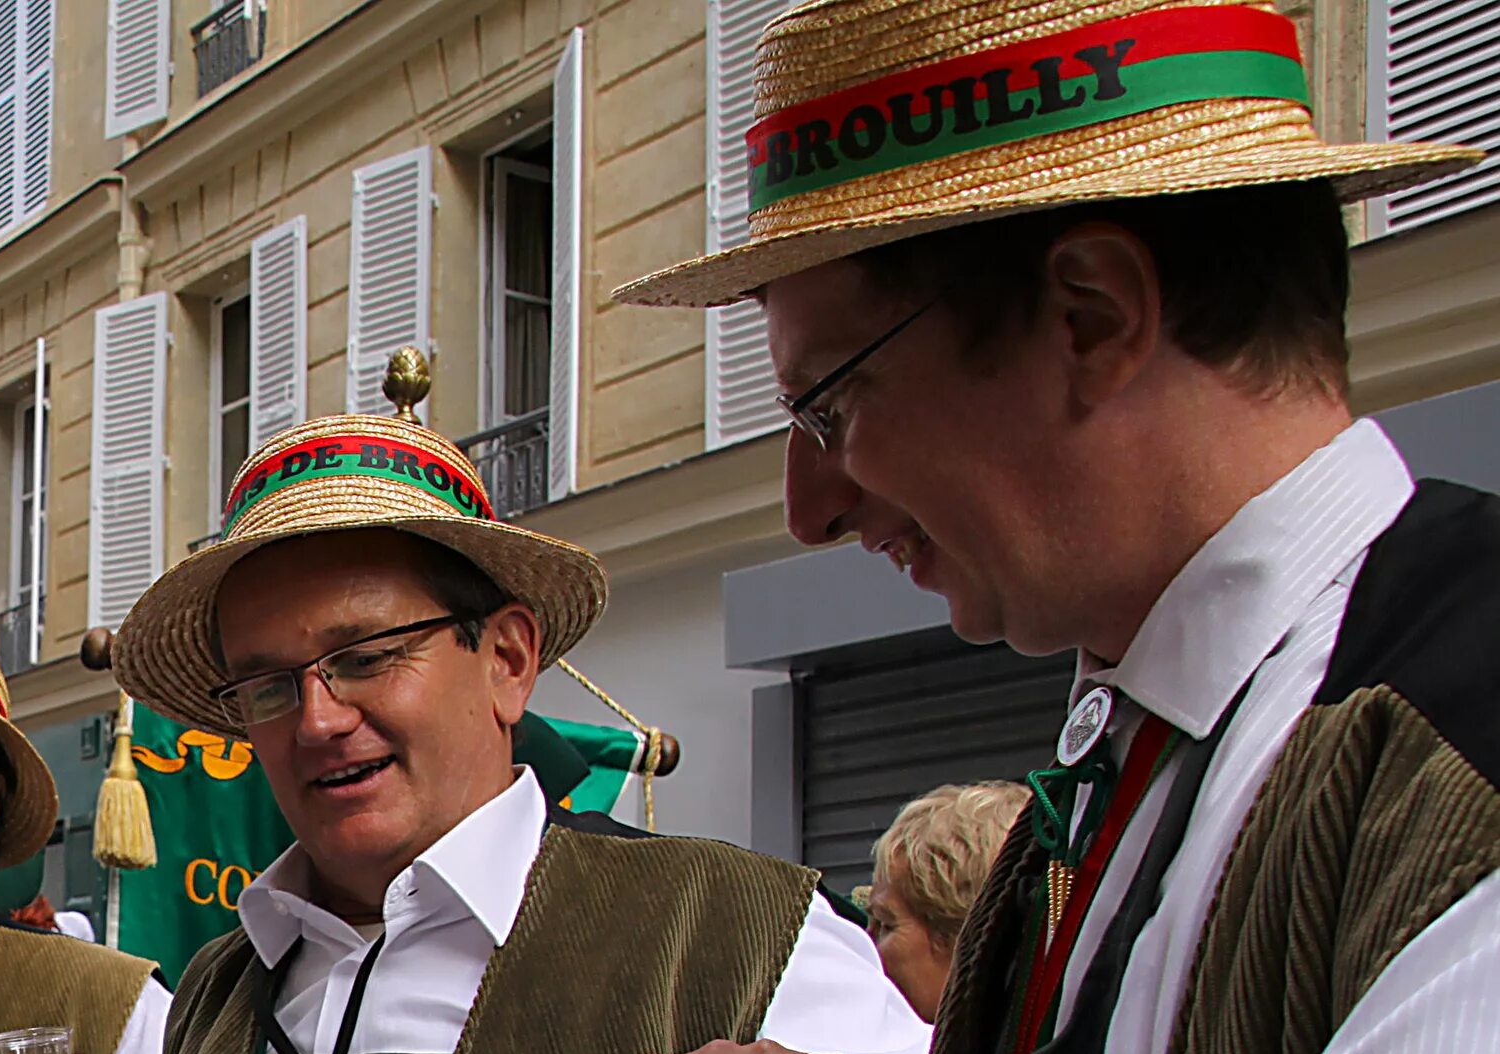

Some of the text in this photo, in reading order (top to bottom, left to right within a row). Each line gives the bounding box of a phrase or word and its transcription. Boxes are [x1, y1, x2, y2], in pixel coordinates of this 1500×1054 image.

[765, 38, 1137, 188] BROUILLY
[278, 443, 344, 482] DE
[184, 858, 263, 911] CO
